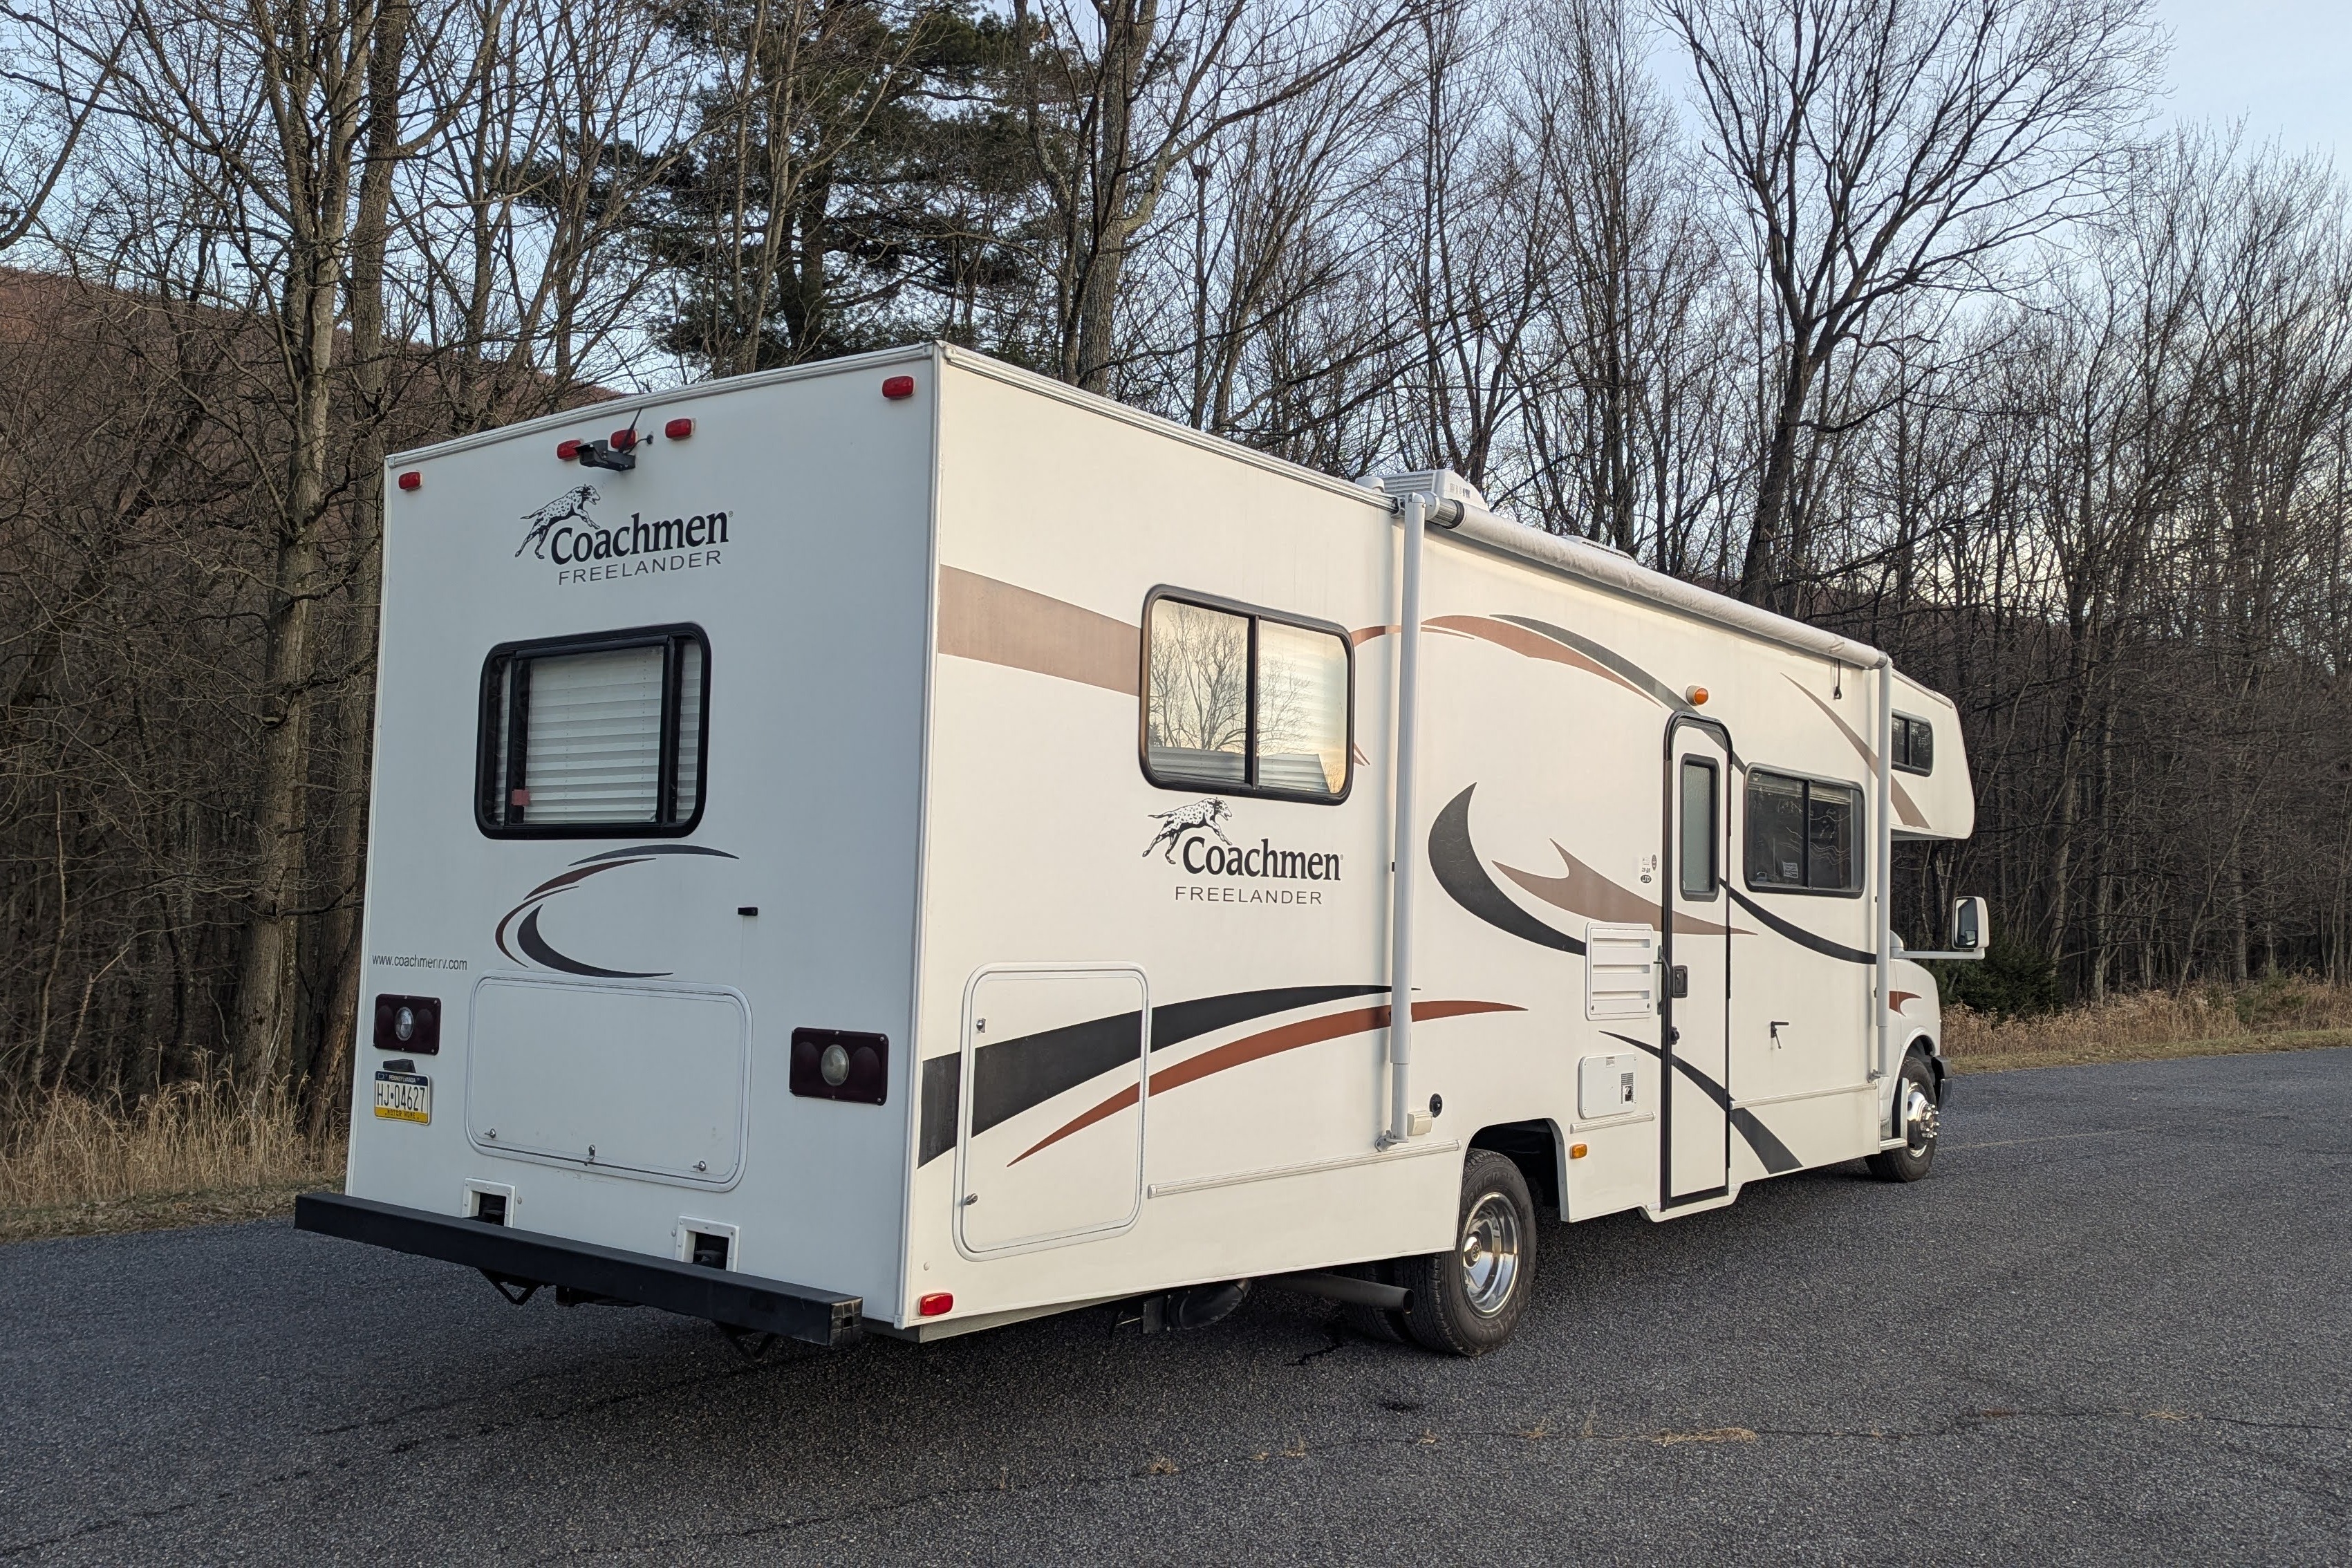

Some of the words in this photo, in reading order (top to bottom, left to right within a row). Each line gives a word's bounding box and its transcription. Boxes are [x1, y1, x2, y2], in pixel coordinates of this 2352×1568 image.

[551, 512, 729, 565] Coachmen
[559, 550, 721, 586] FREELANDER
[1183, 837, 1341, 881] Coachmen
[1175, 886, 1322, 904] FREELANDER
[372, 954, 467, 970] www.coachmenrv.com
[389, 1074, 416, 1083] PENNSYLVANIA
